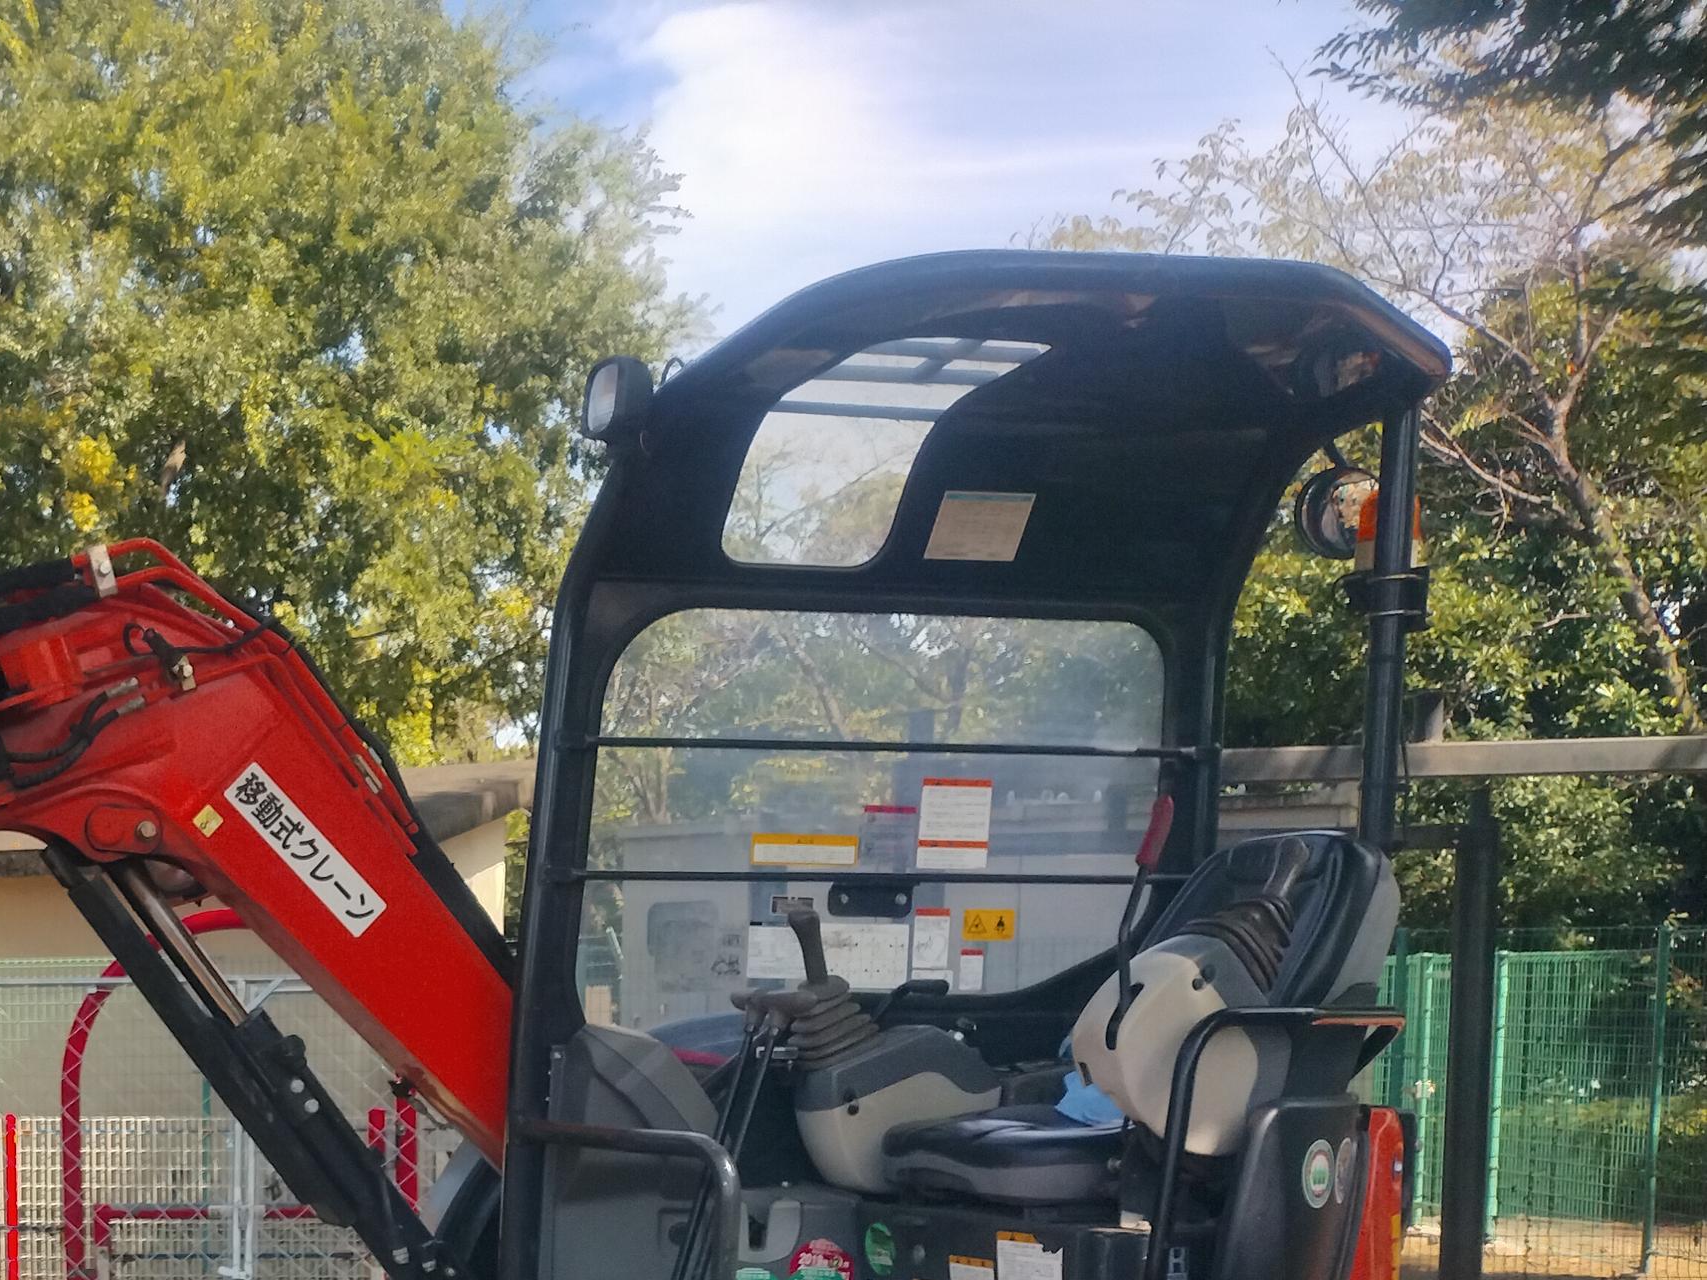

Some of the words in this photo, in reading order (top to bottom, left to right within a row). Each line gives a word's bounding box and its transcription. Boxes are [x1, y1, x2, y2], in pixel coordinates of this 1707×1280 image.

[233, 771, 375, 920] 移動式クレーン
